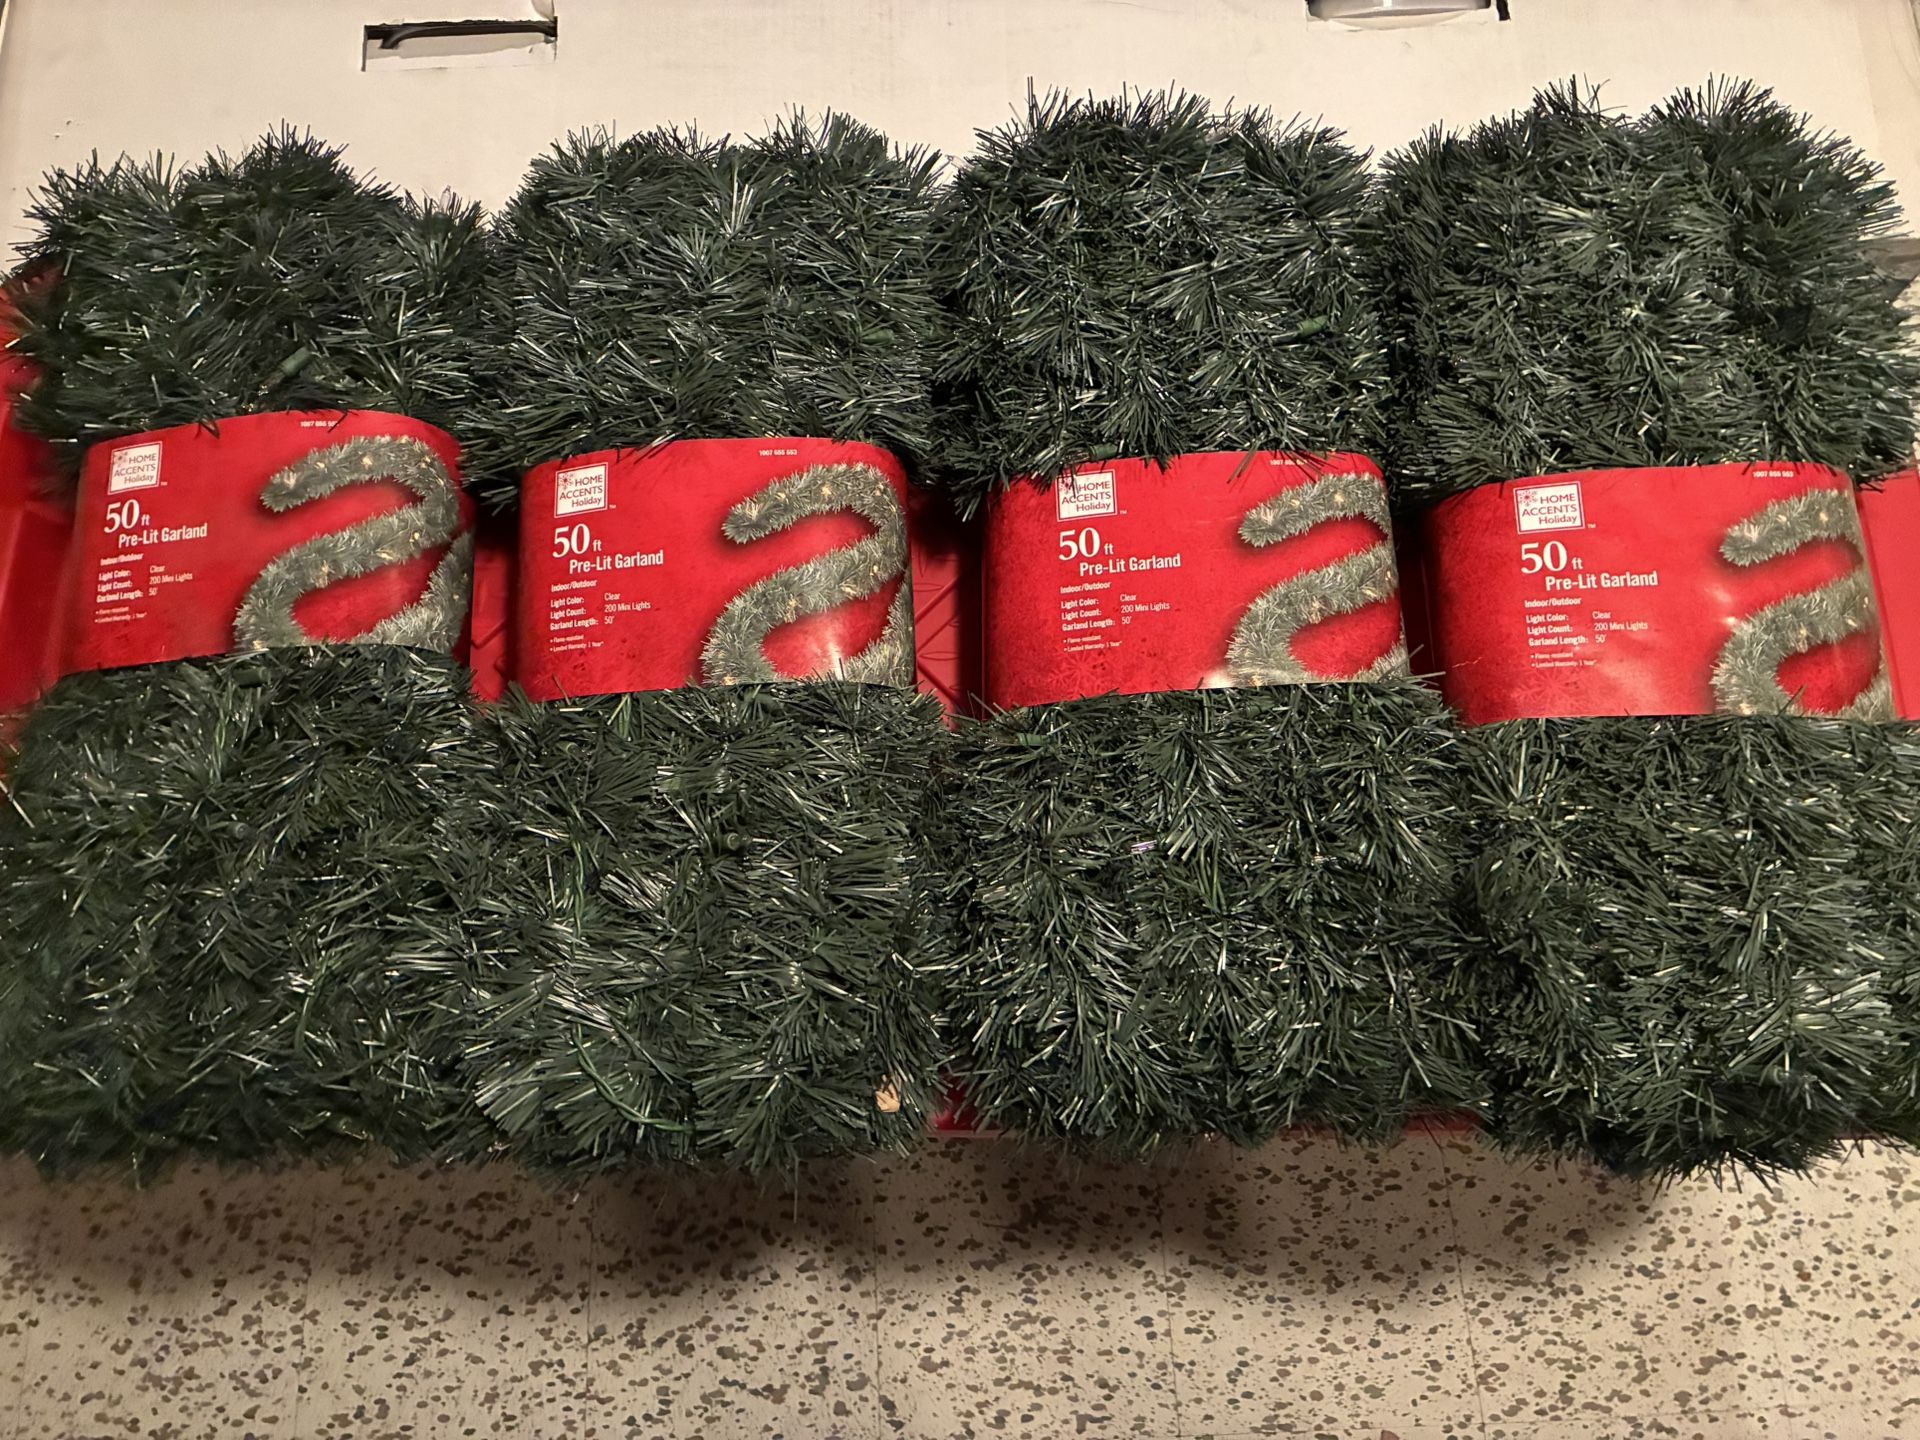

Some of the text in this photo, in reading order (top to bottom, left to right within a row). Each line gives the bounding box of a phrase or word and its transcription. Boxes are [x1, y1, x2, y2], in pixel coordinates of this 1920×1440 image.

[128, 453, 156, 464] HOME
[114, 464, 156, 478] ACCENTS
[124, 474, 154, 484] Holiday
[574, 474, 602, 486] HOME
[1078, 480, 1110, 491] HOME
[560, 486, 603, 500] ACCENTS
[1062, 492, 1112, 504] ACCENTS
[1540, 494, 1576, 504] HOME
[572, 496, 602, 508] Holiday
[1076, 502, 1110, 512] Holiday
[104, 499, 150, 533] 50 ft
[1522, 504, 1576, 517] ACCENTS
[1538, 515, 1577, 525] Holiday
[118, 522, 208, 548] Pre-Lit Garland
[552, 524, 602, 558] 50 ft
[1058, 528, 1114, 560] 50 ft
[570, 550, 664, 574] Pre-Lit Garland
[1521, 540, 1583, 574] 50 ft
[1080, 553, 1181, 576] Pre-Lit Garland
[551, 580, 598, 592] Indoor/Outdoor
[1545, 570, 1658, 591] Pre-Lit Garland
[1060, 582, 1112, 594] Indoor/Outdoor
[550, 592, 620, 608] Light Color: Clear
[1061, 594, 1136, 610] Light Color: Clear
[1524, 597, 1582, 608] Indoor/Outdoor
[550, 601, 651, 620] Light Count: 200 Mini Lights
[1062, 602, 1170, 621] Light Count: 200 Mini Lights
[550, 620, 574, 630] Garland
[574, 618, 598, 628] Length:
[1526, 611, 1611, 624] Light Color: Clear
[1062, 622, 1088, 632] Garland
[1090, 618, 1115, 628] Length:
[1528, 622, 1648, 635] Light Count: 200 Mini Lights
[1528, 638, 1558, 646] Garland
[1560, 635, 1588, 644] Length:
